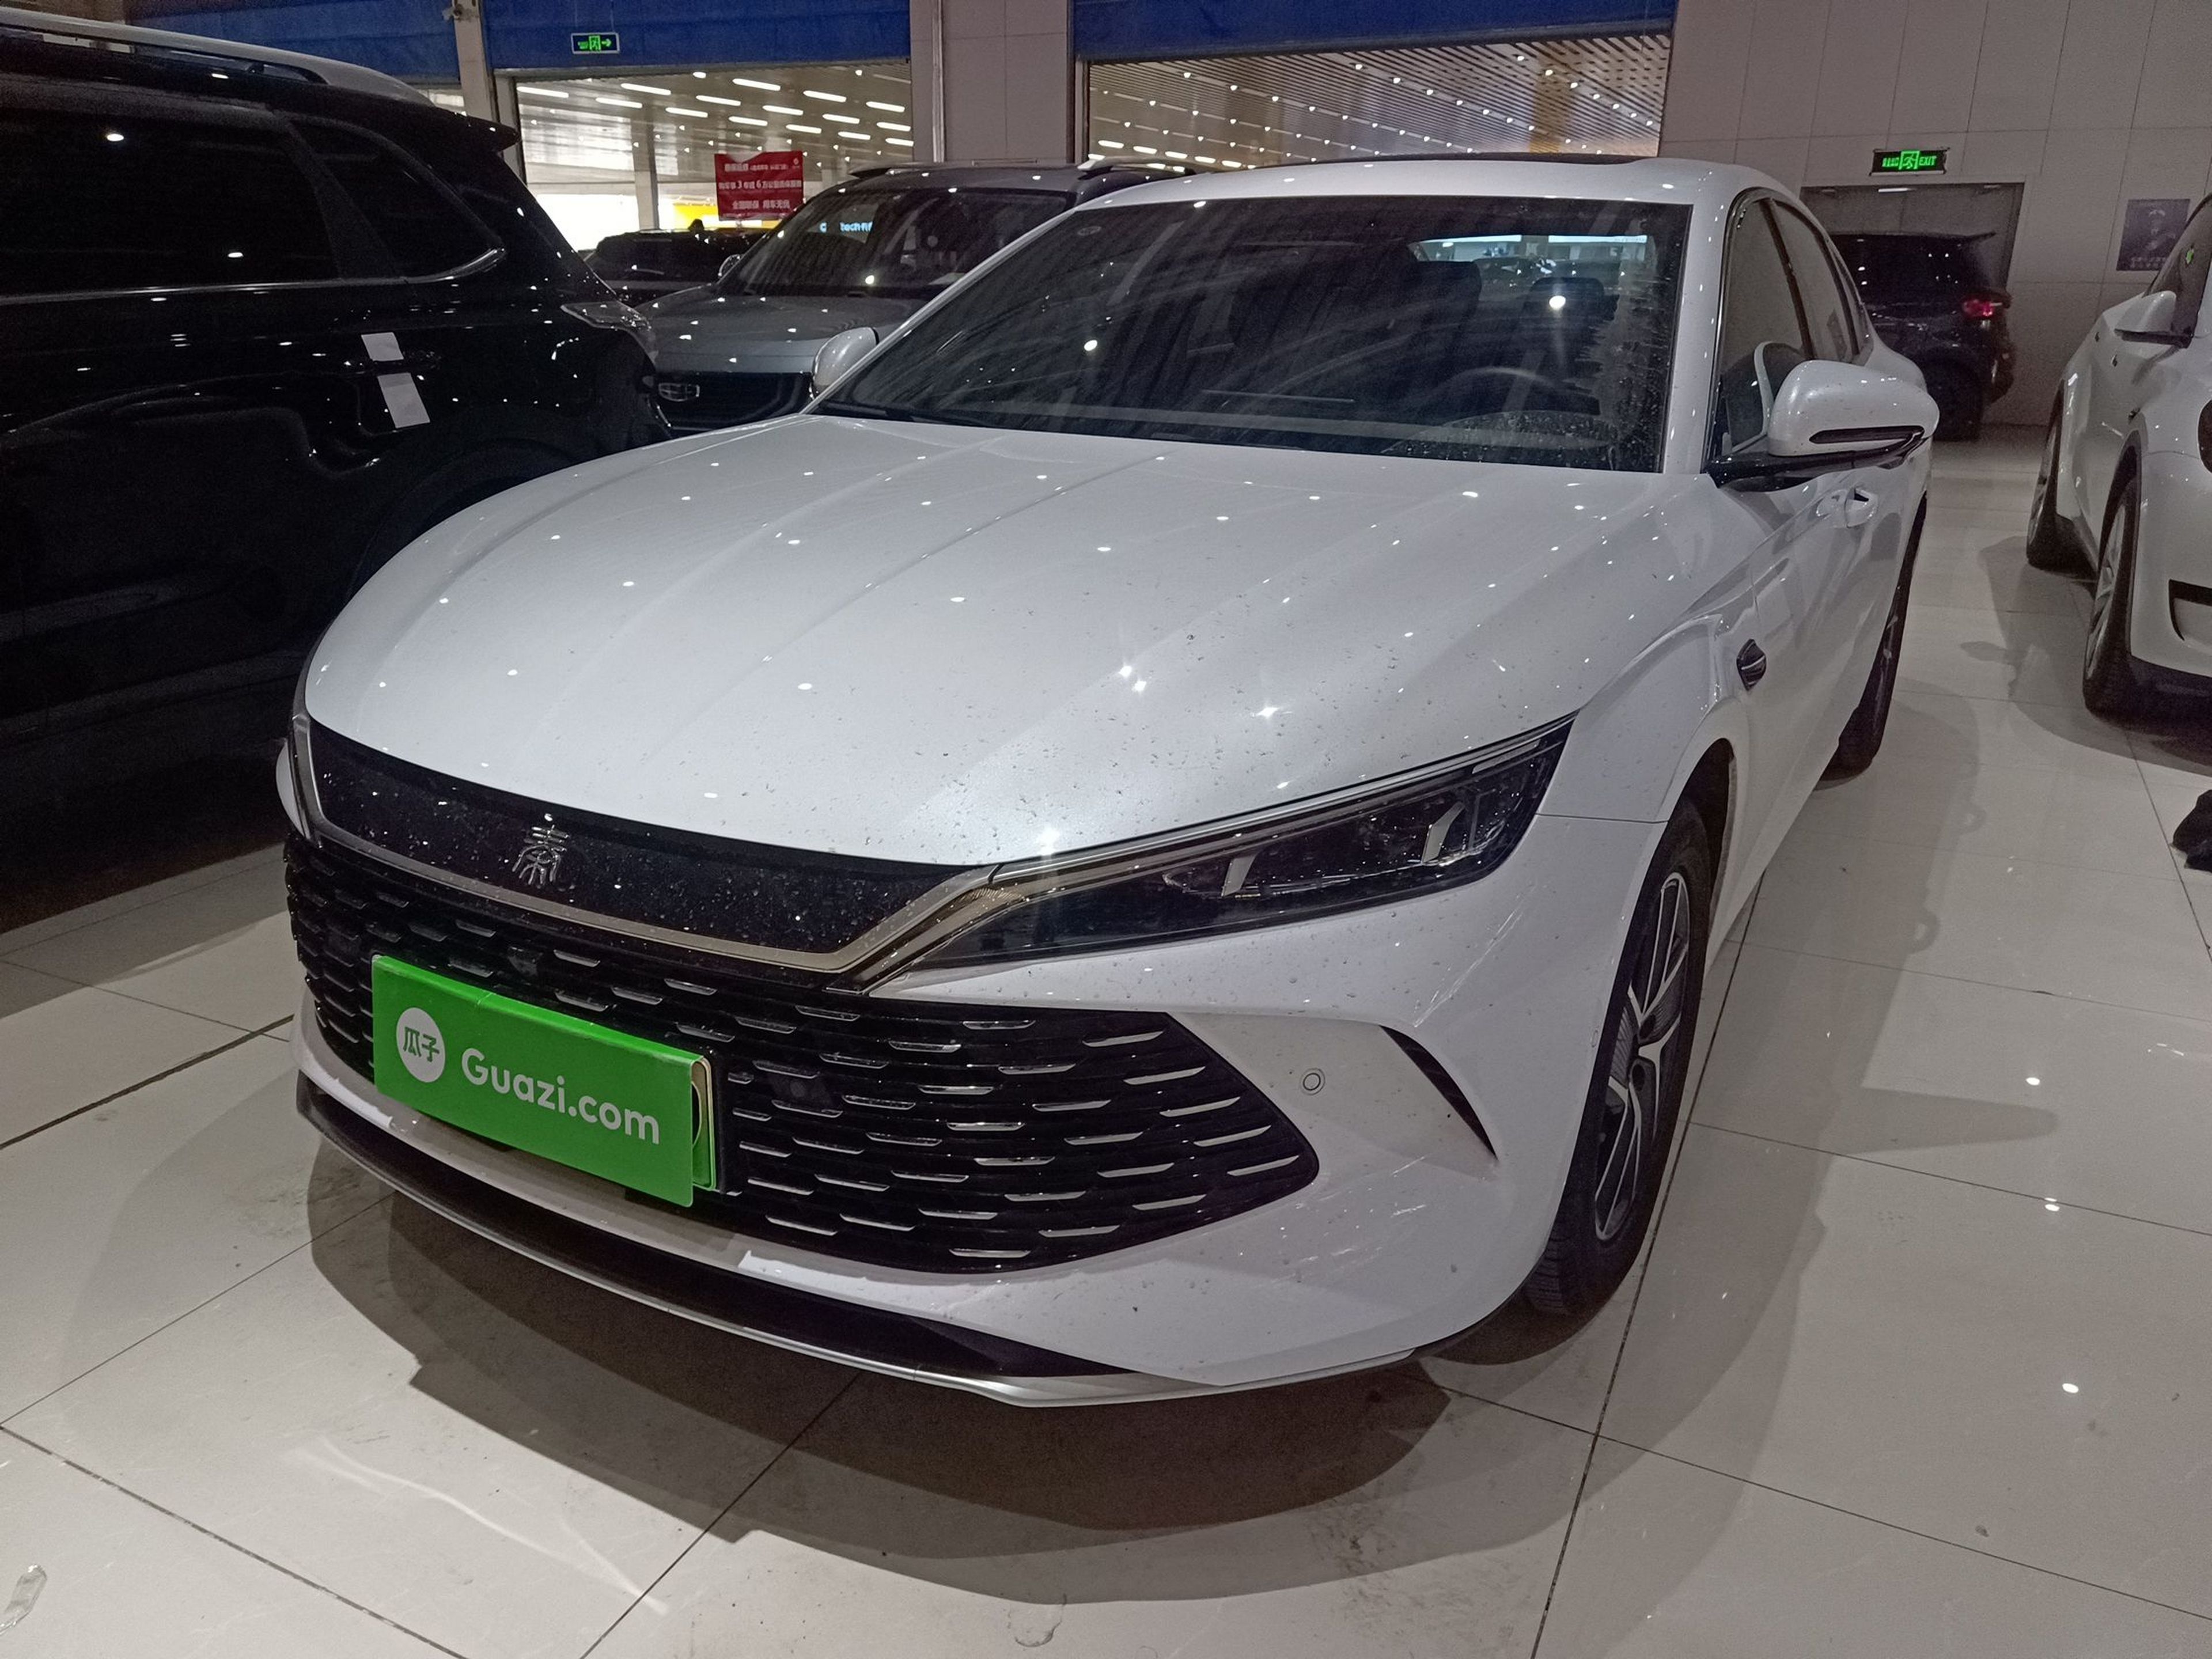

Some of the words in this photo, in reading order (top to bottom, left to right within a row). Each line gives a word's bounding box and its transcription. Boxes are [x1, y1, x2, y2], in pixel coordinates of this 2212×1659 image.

[1919, 156, 1937, 166] EXIT
[403, 1024, 441, 1063] 瓜子
[461, 1048, 660, 1145] Guazi.com
